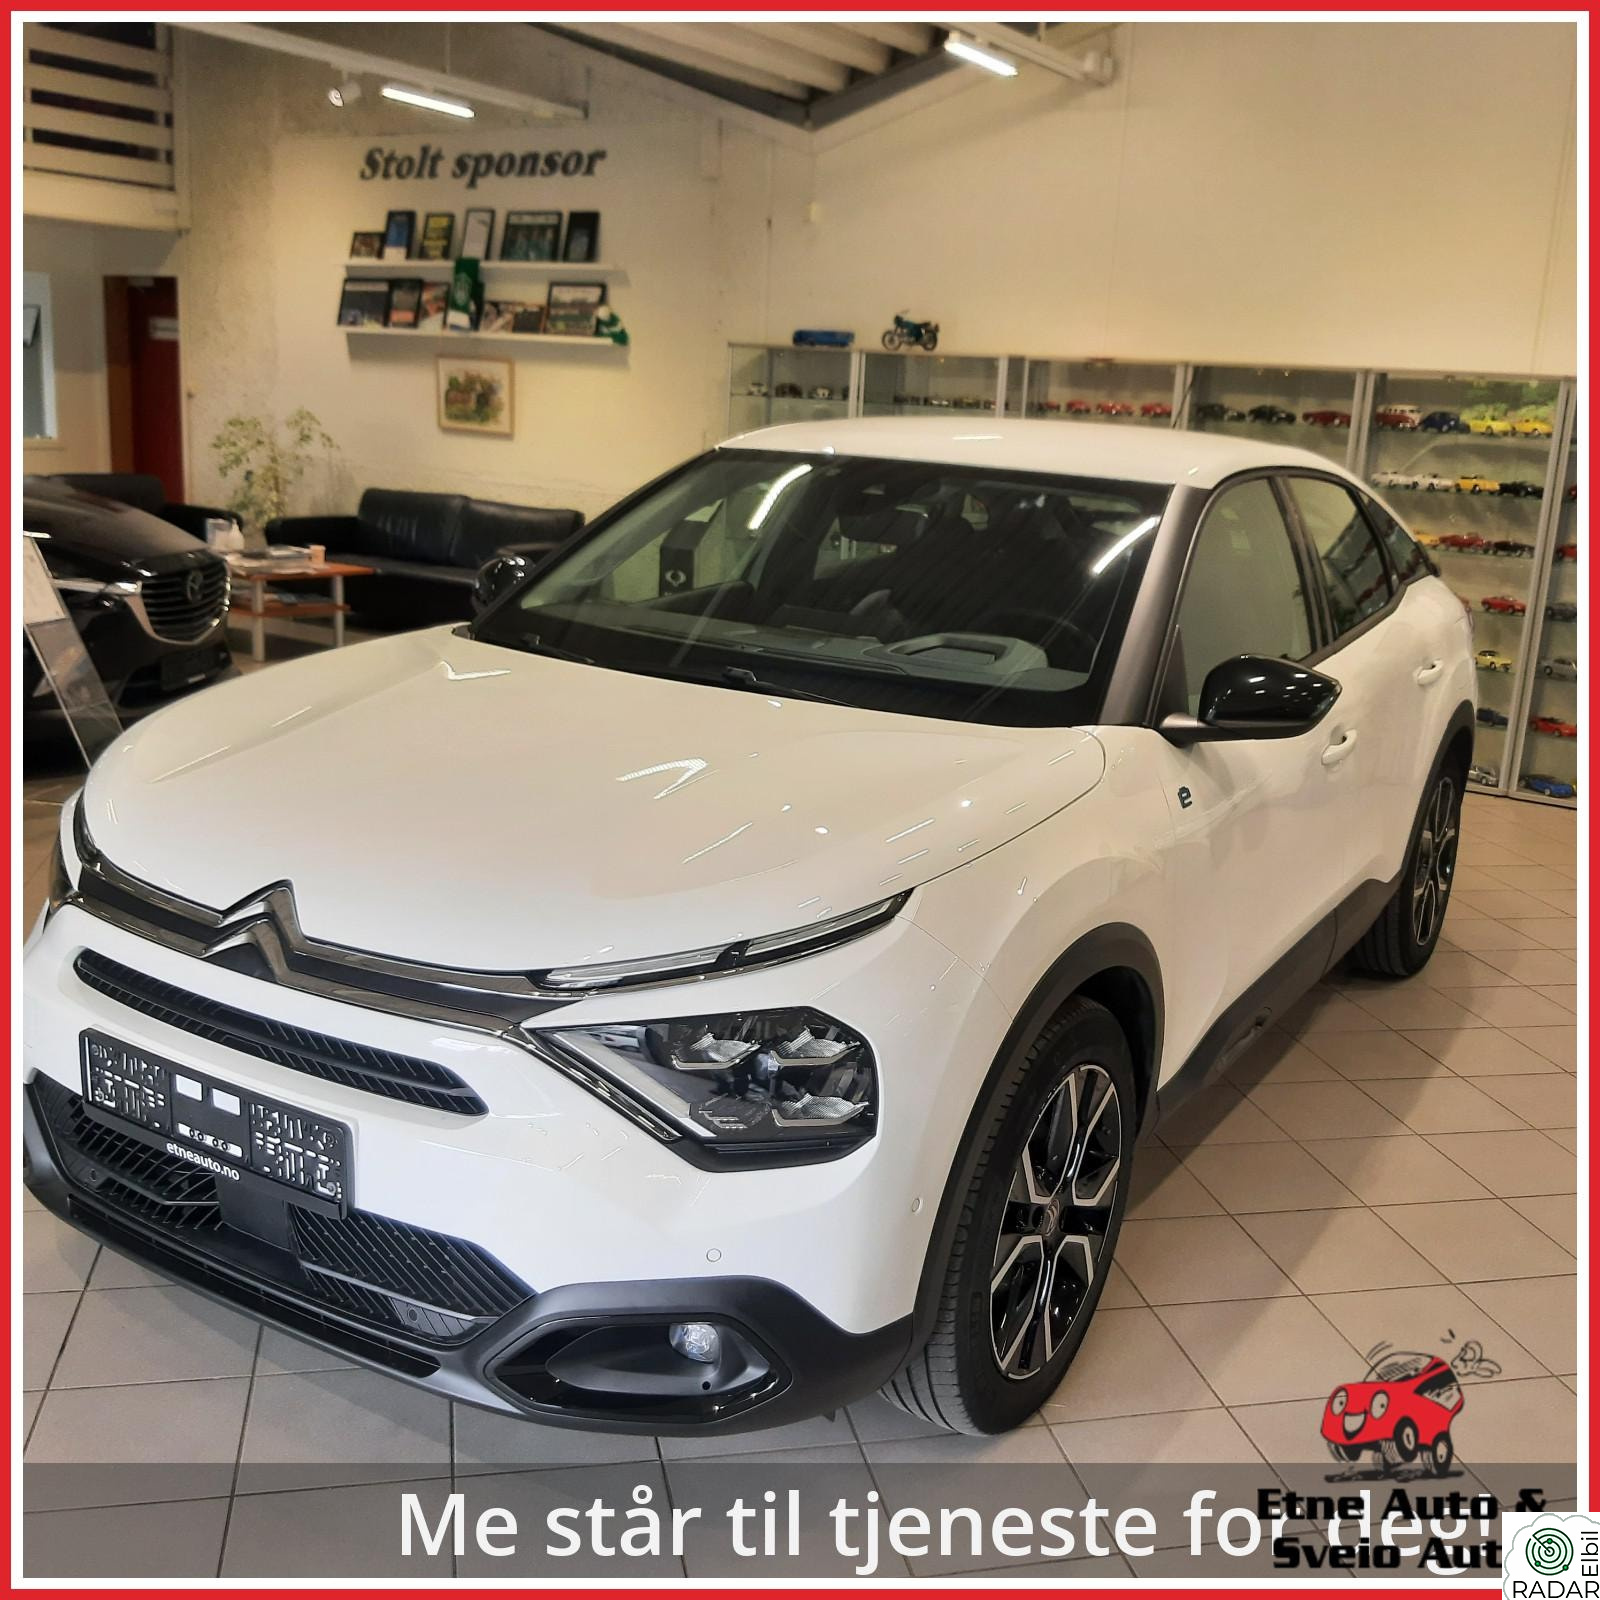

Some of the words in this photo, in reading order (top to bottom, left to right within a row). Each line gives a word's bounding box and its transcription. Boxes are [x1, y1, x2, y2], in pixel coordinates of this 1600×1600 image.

[360, 145, 444, 180] Stolt
[452, 149, 606, 189] sponsor
[166, 1142, 240, 1181] etneauto.no
